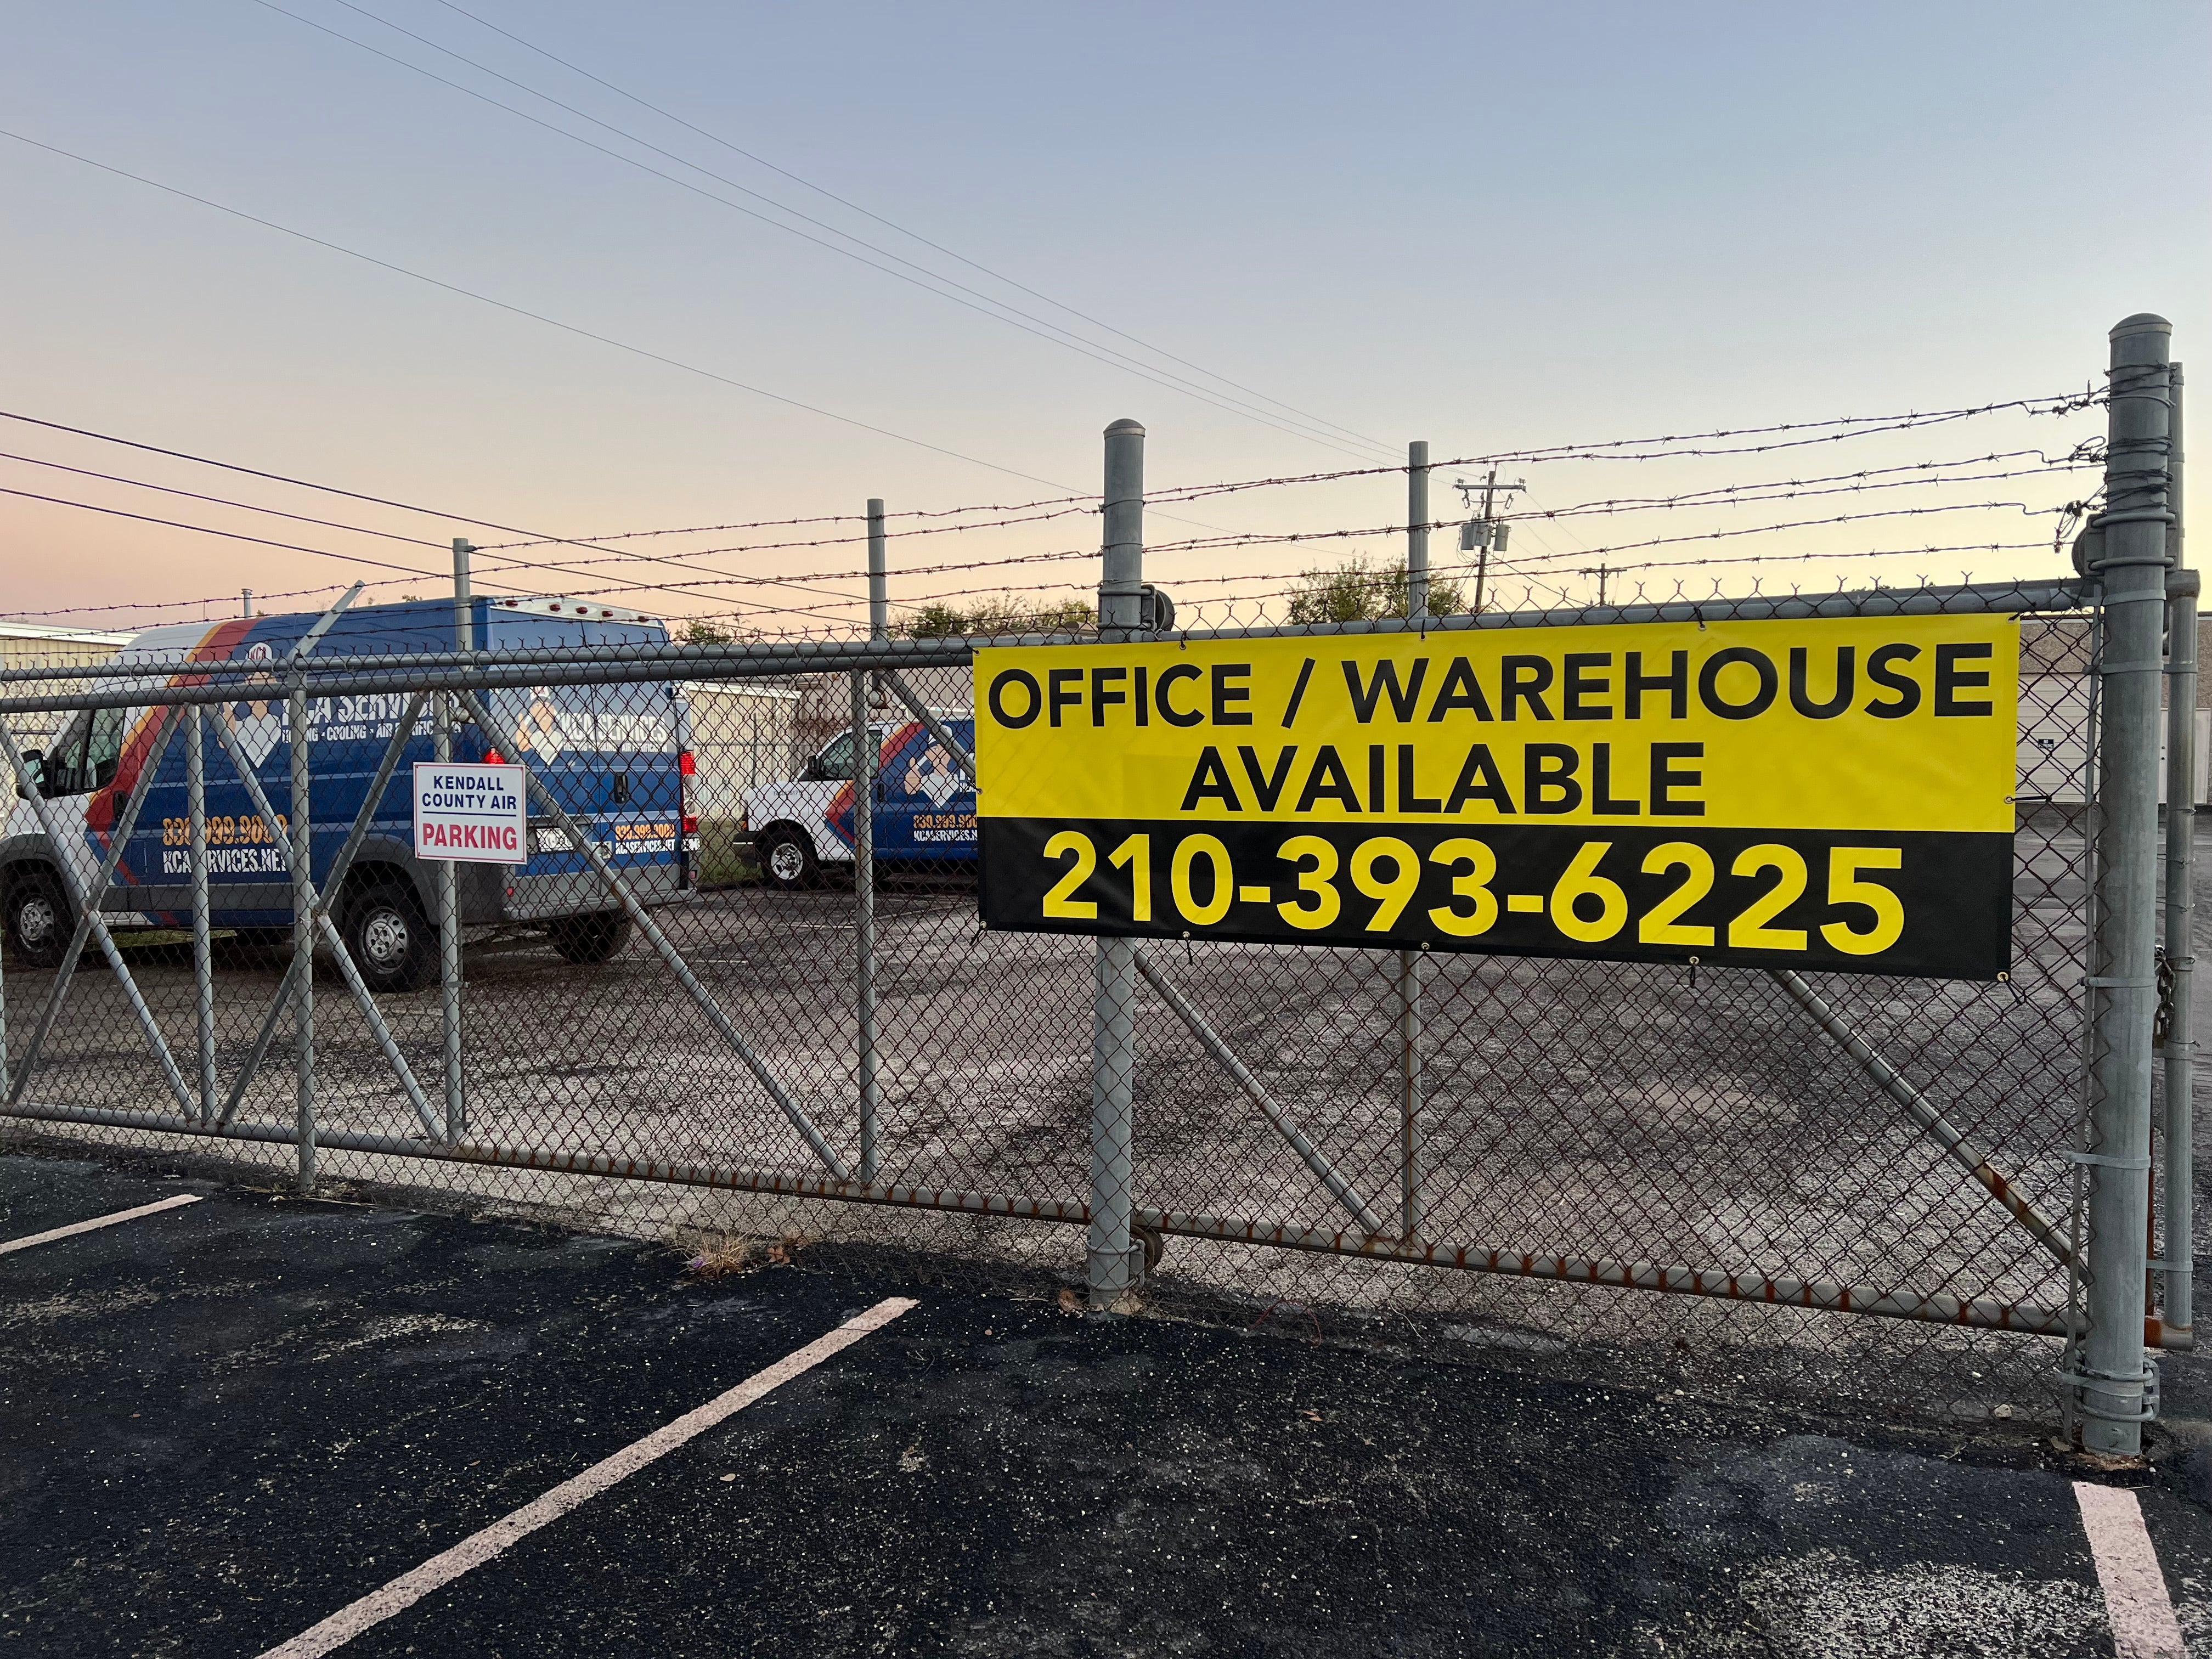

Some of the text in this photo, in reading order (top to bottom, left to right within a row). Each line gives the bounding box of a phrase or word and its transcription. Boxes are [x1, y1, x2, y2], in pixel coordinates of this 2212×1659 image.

[988, 642, 1993, 729] OFFICE / WAREHOUSE
[326, 725, 366, 741] COOLING
[376, 723, 393, 738] AIR
[434, 776, 504, 791] KENDALL
[1180, 742, 1706, 816] AVAILABLE
[422, 793, 516, 809] COUNTY AIR
[423, 823, 517, 850] PARKING
[1043, 831, 1905, 956] 210-393-6225
